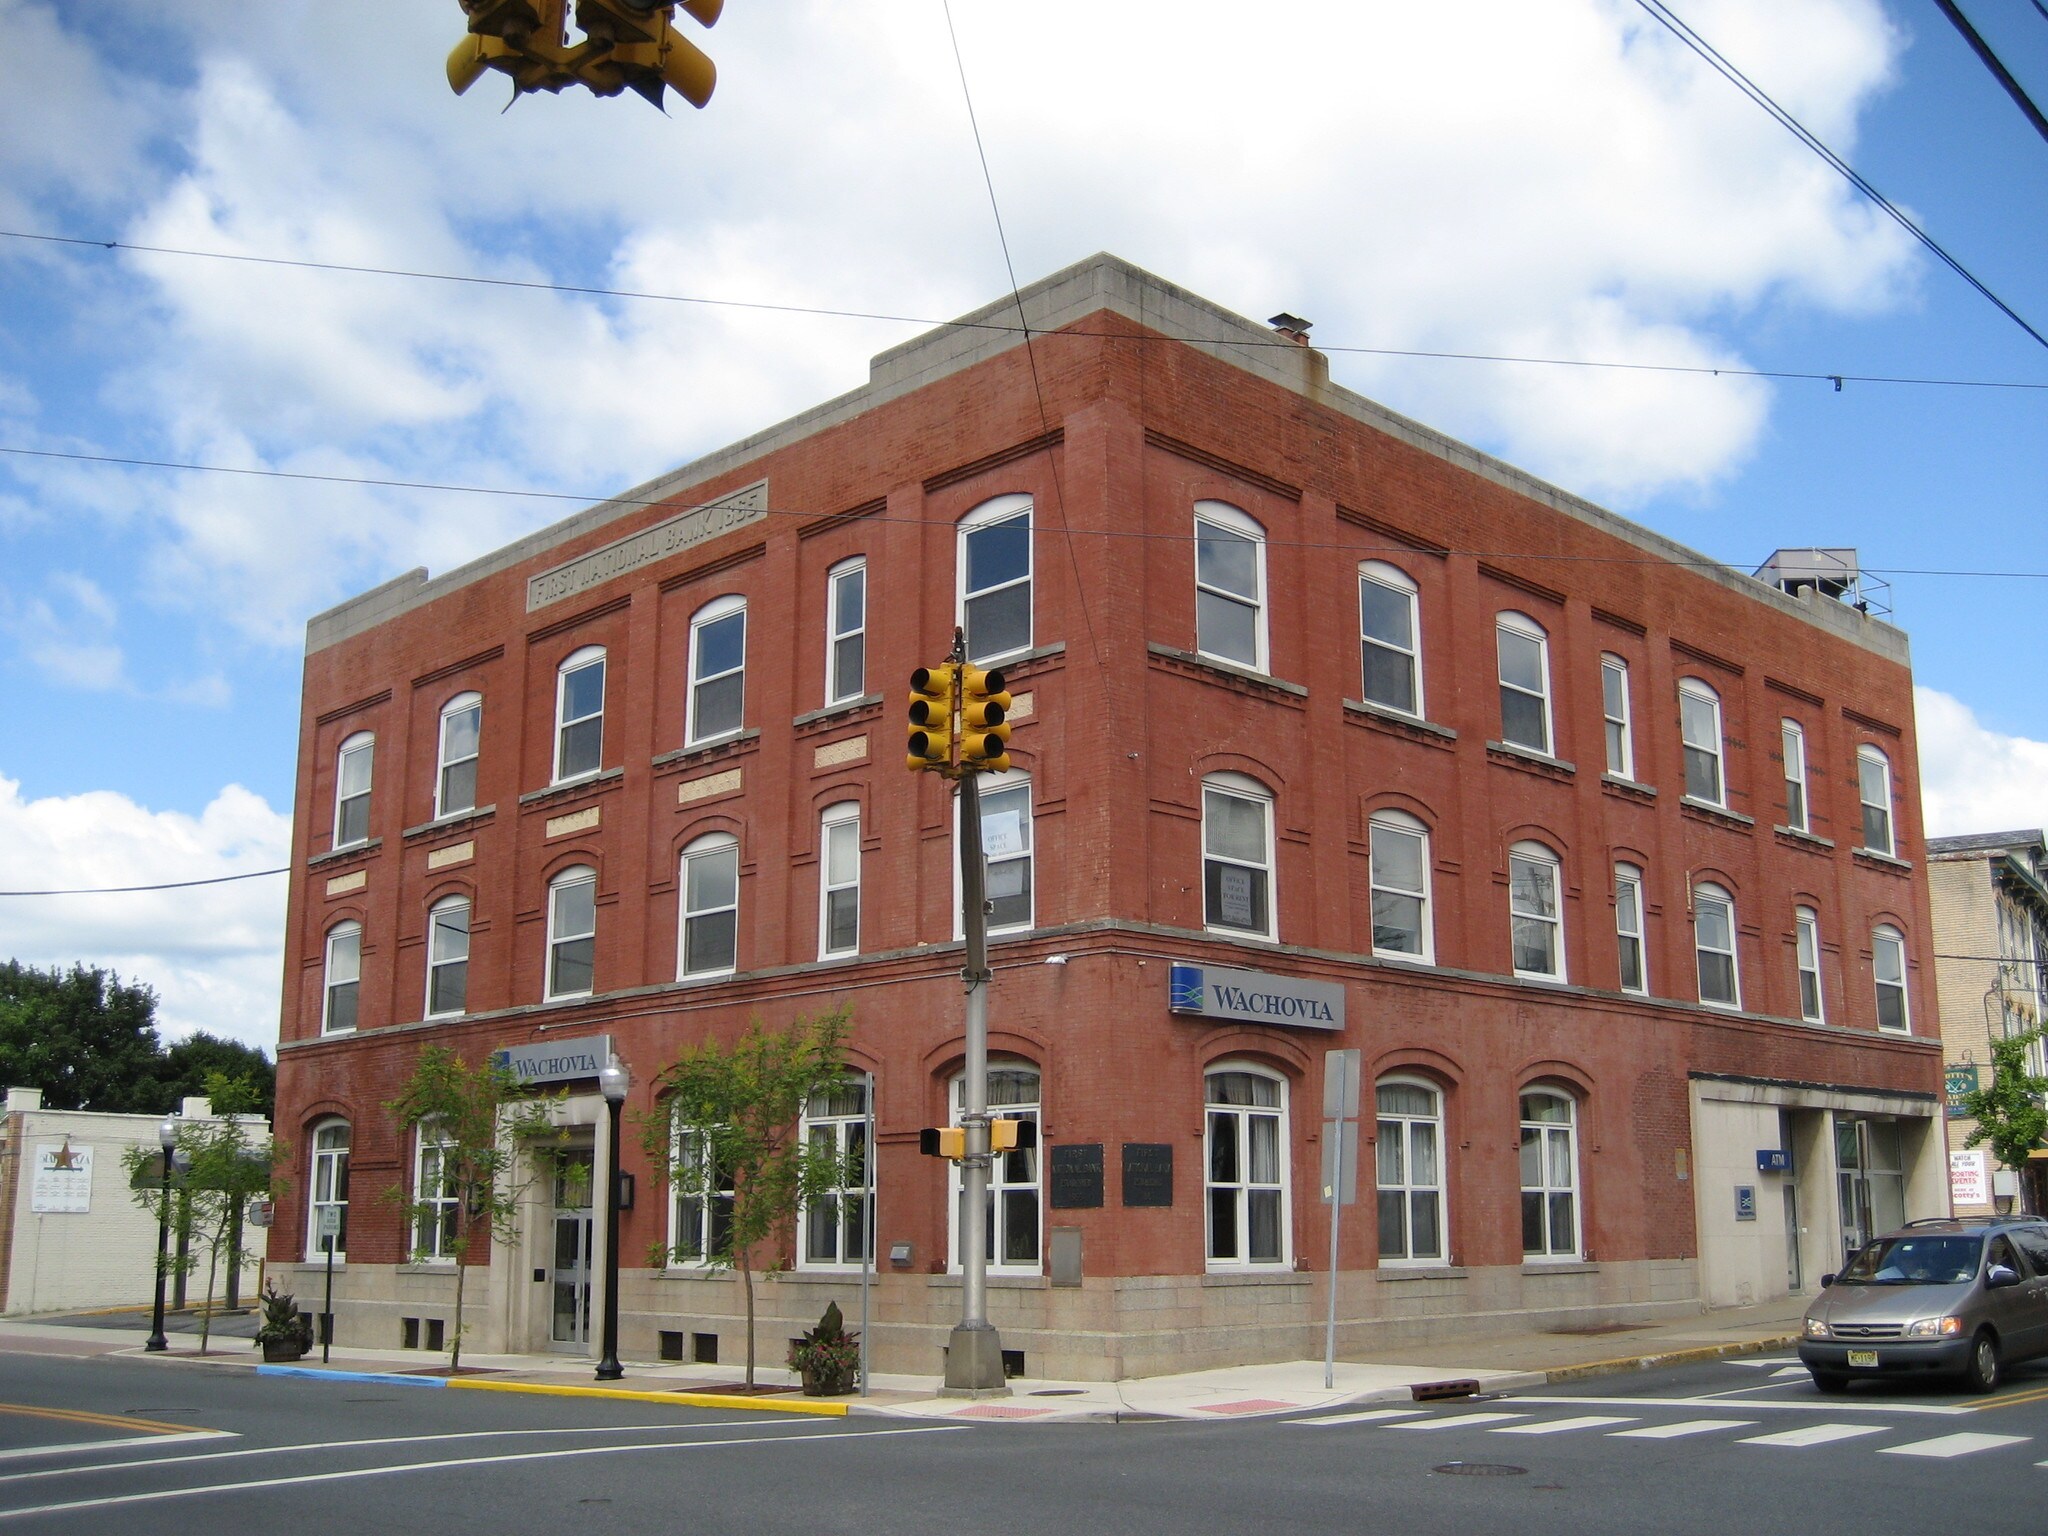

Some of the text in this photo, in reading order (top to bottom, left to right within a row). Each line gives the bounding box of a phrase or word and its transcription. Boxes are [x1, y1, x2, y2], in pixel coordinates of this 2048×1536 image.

[535, 568, 577, 604] FIRST
[580, 533, 659, 586] NATIONAL
[665, 508, 712, 551] BANK
[987, 833, 1007, 842] OFFICE
[1226, 876, 1244, 885] OFFICE
[1236, 895, 1249, 903] RENT
[1212, 985, 1334, 1021] WACHOVIA
[515, 1054, 597, 1077] WACHOVIA
[1945, 1072, 1973, 1081] OTTY'S
[1065, 1149, 1088, 1158] FIRST
[1771, 1154, 1785, 1166] ATM
